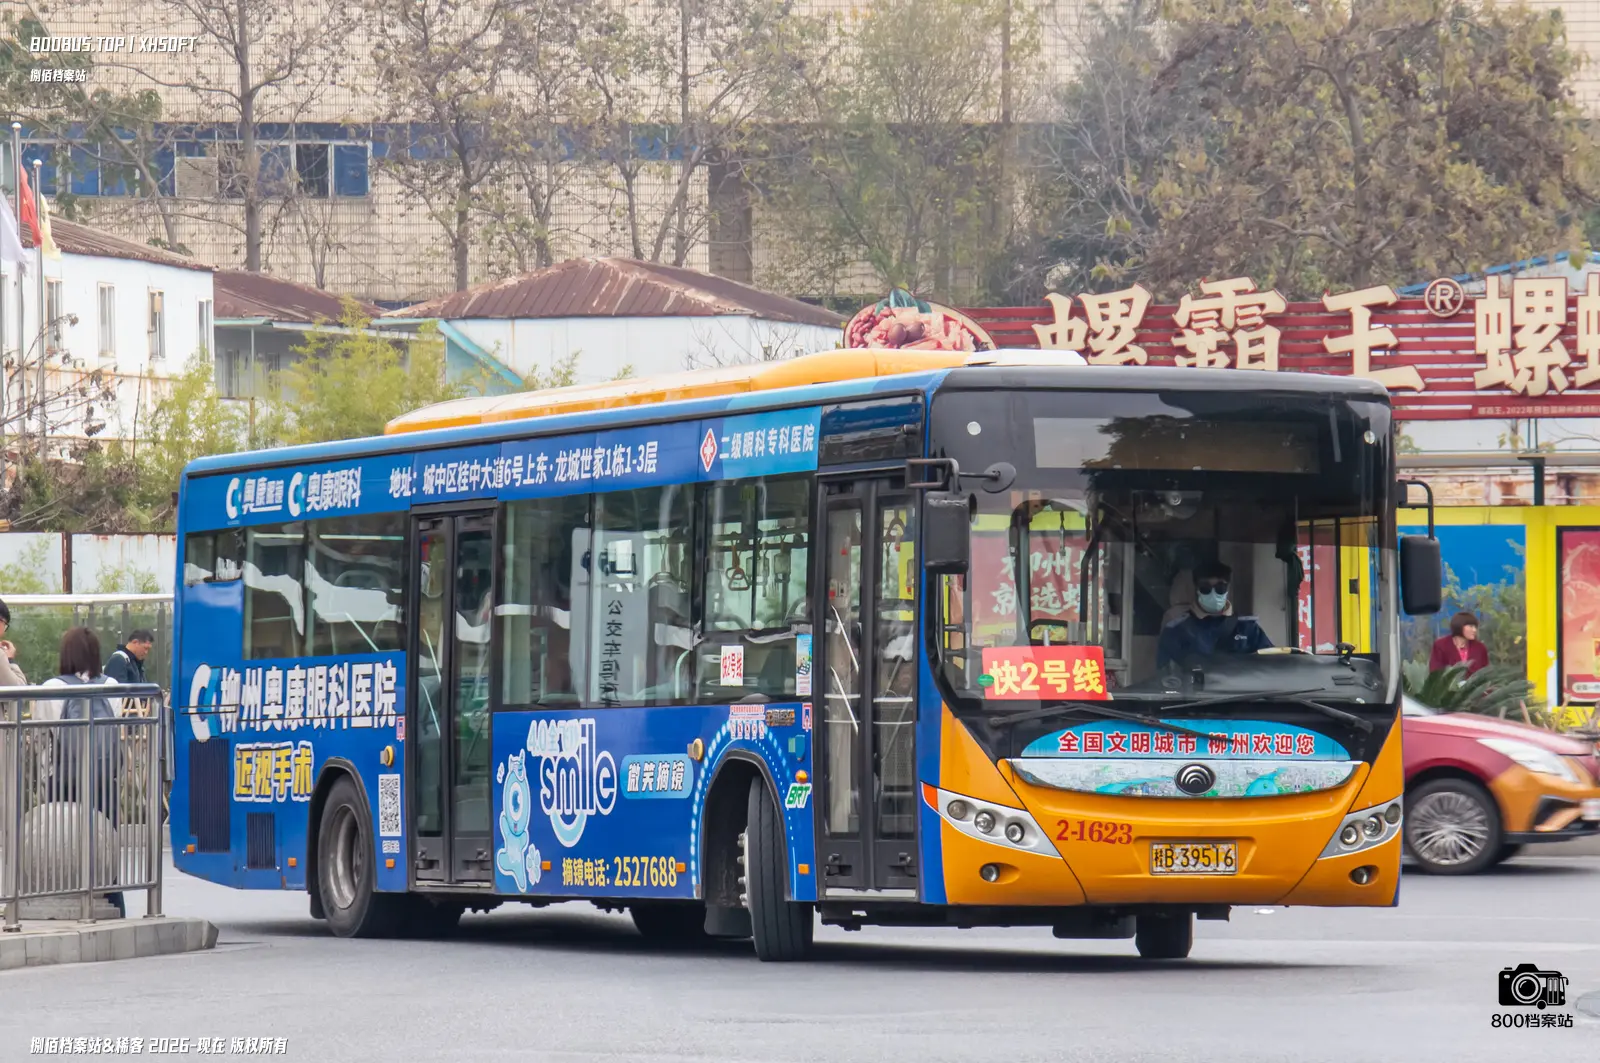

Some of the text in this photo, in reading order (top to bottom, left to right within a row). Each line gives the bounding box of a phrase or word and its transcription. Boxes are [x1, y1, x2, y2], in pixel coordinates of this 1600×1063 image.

[719, 423, 816, 460] 二级眼科专科医院
[988, 658, 1104, 696] 快2号线
[219, 659, 397, 733] 柳州奥康眼科医院
[1058, 731, 1315, 755] 全国文明城市 柳州欢迎您
[234, 741, 314, 802] 近视手术
[627, 760, 685, 793] 微笑摘镜
[787, 783, 812, 807] BRT
[1056, 819, 1133, 845] 2-1623
